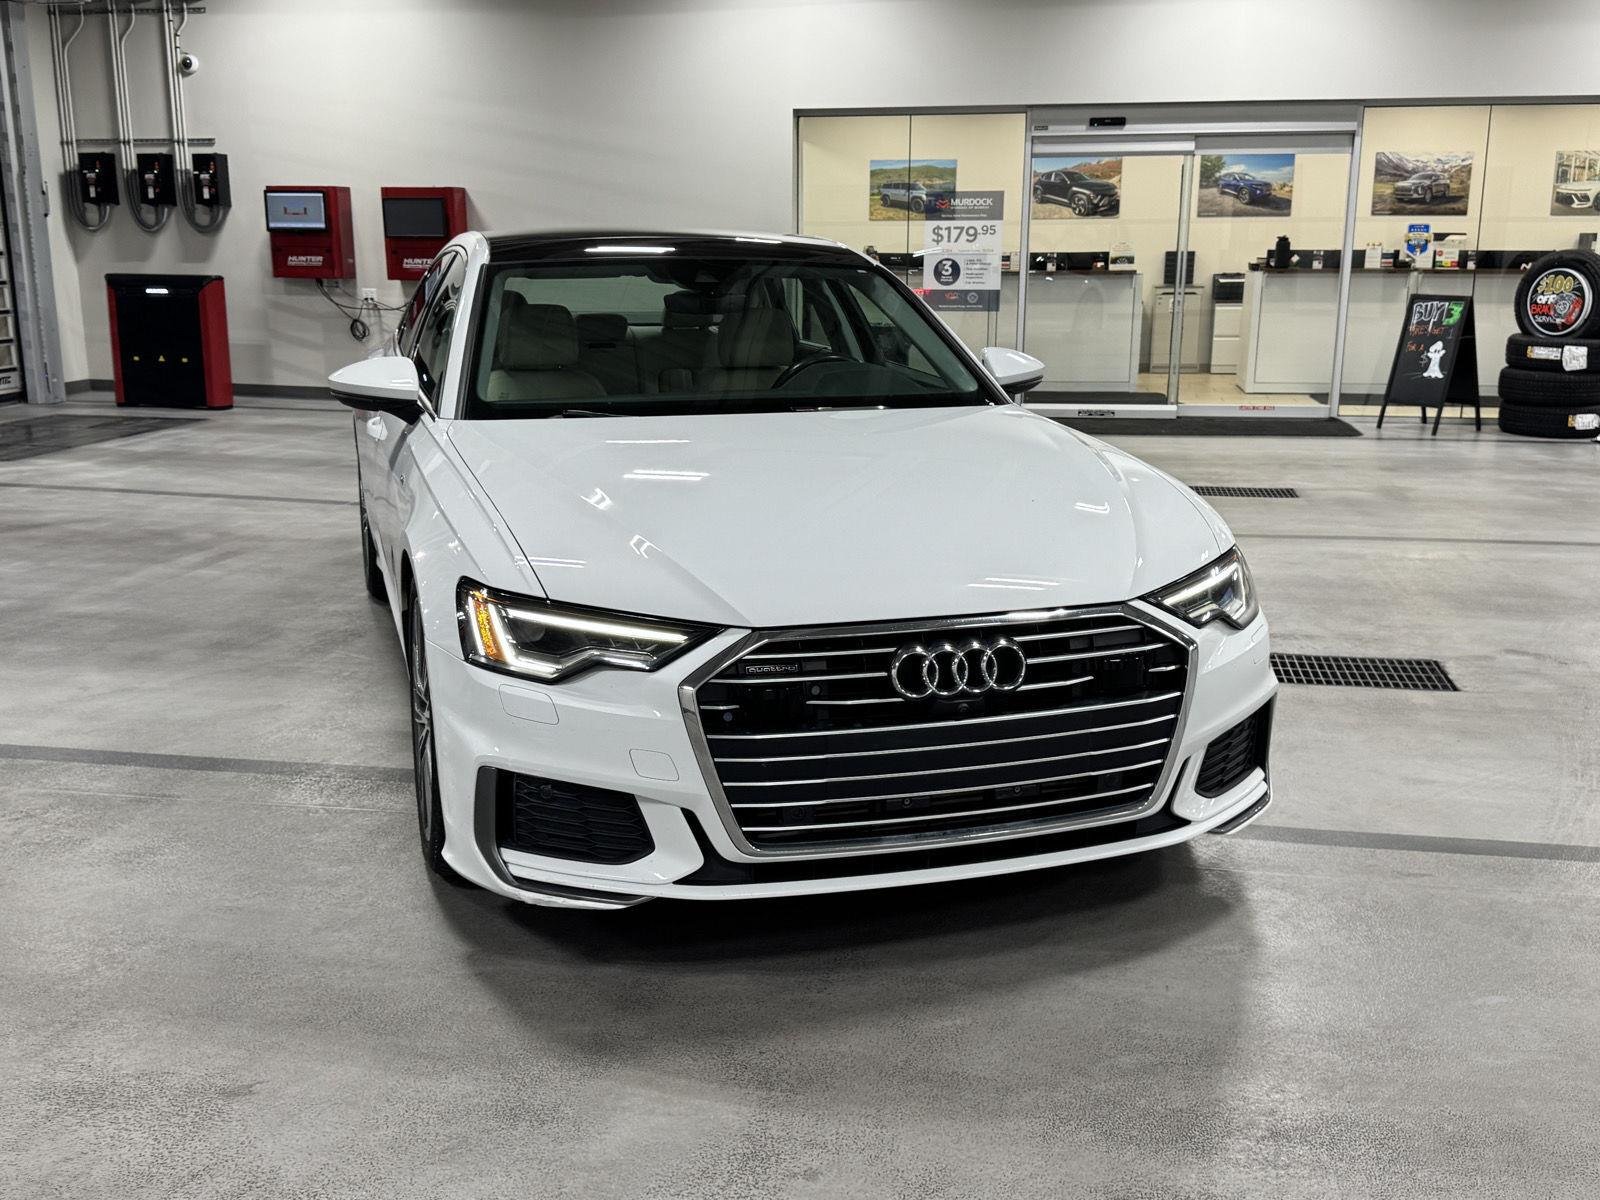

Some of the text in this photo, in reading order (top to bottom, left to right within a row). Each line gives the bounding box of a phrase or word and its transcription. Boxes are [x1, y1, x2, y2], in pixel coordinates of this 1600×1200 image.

[950, 197, 993, 206] MURDOCK
[931, 225, 996, 245] $179.95
[288, 255, 324, 263] HUNTER
[941, 260, 953, 276] 3
[1537, 275, 1574, 295] $100
[1537, 295, 1556, 304] OFF
[1411, 301, 1465, 326] BUY 3
[748, 665, 796, 673] quattro
